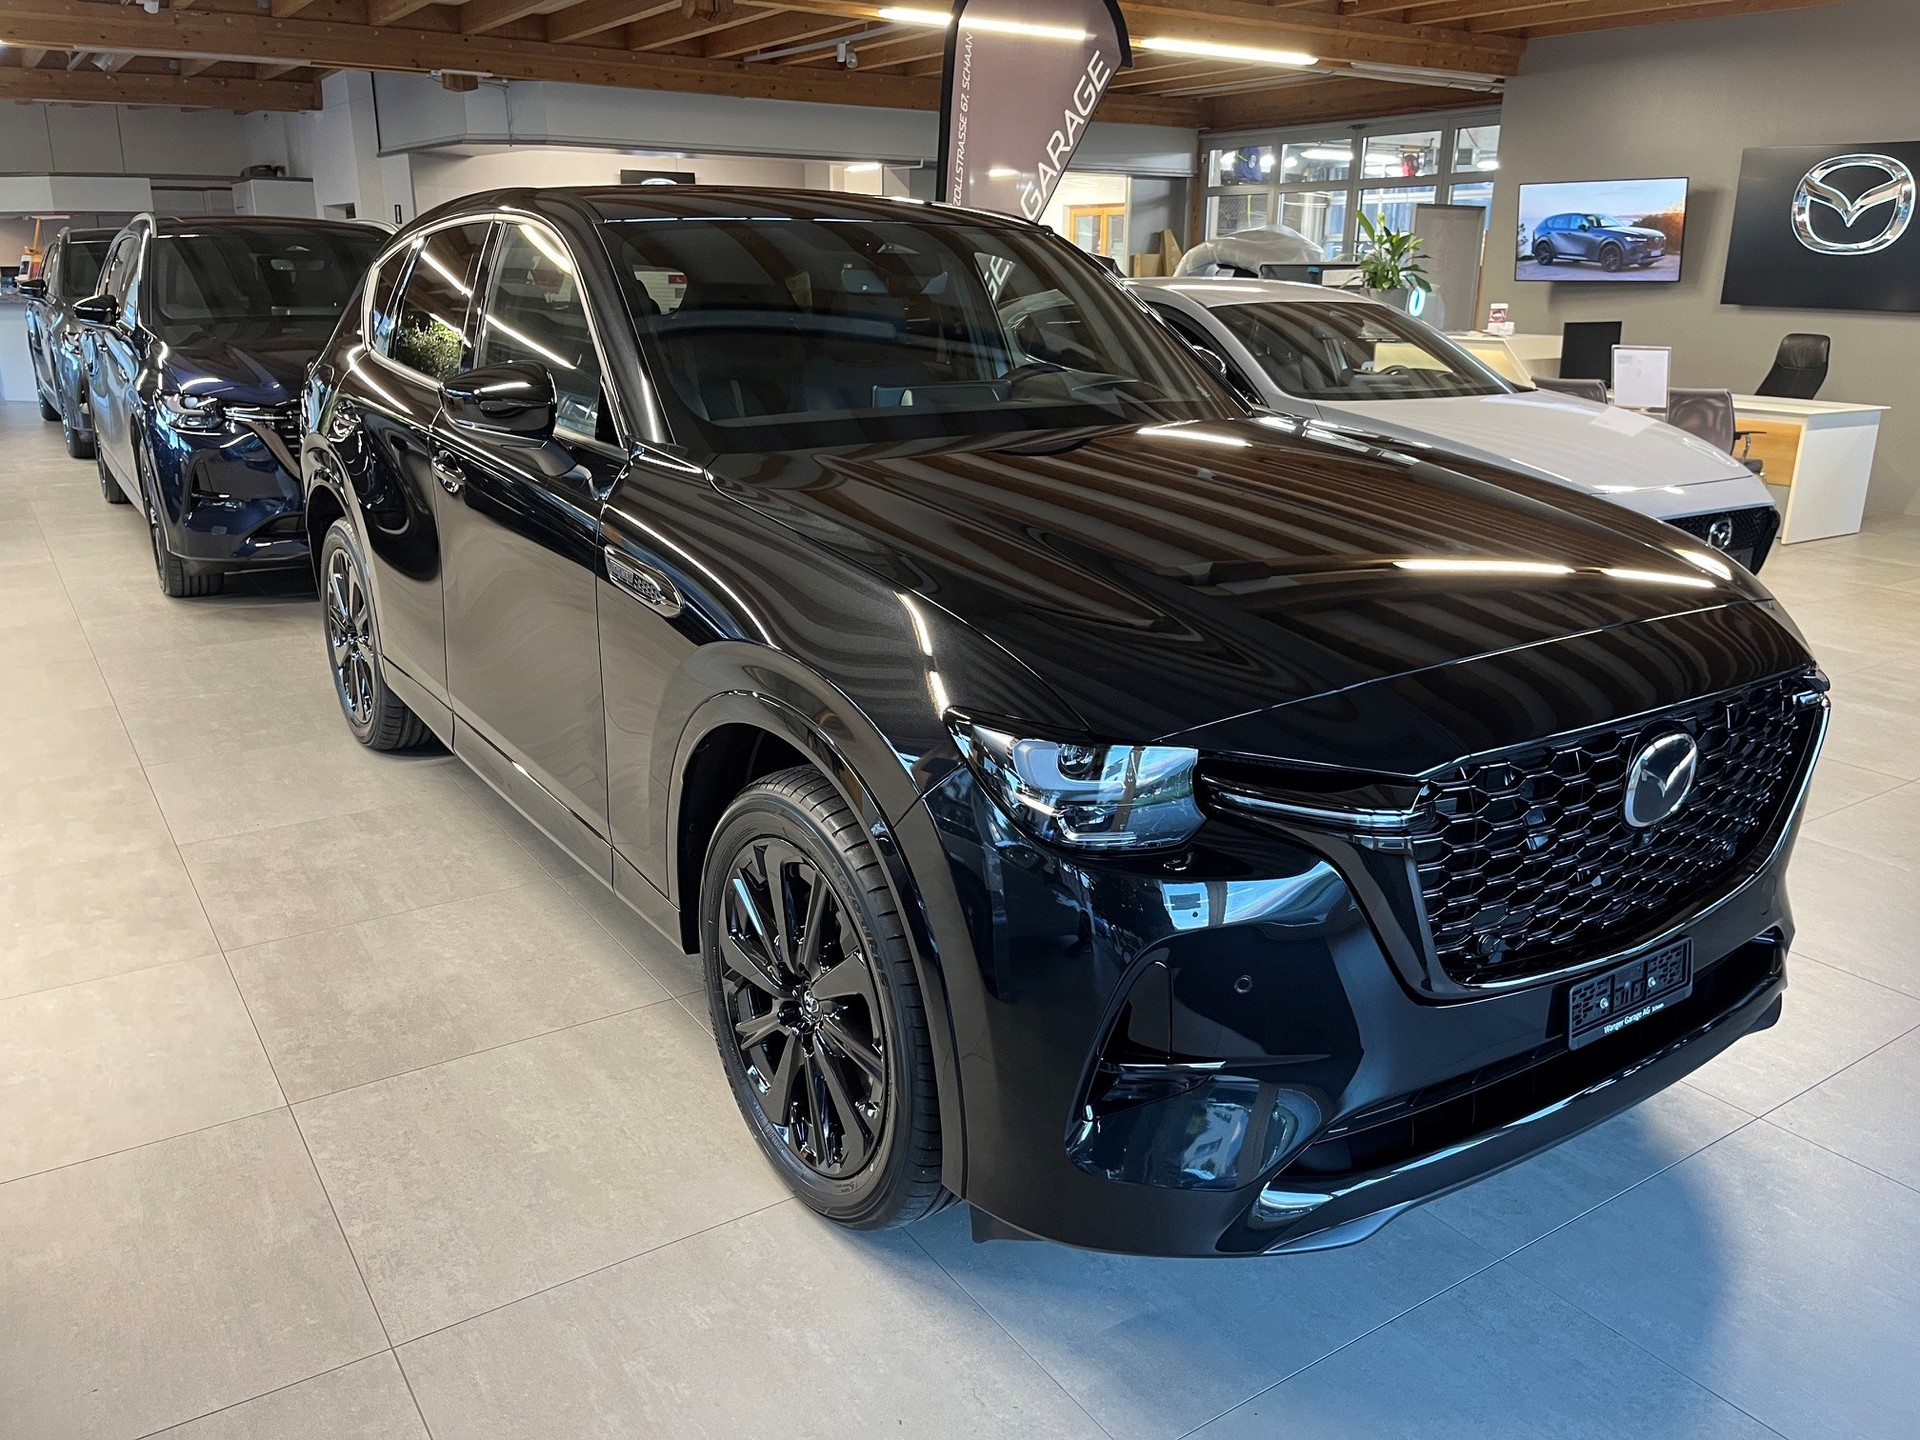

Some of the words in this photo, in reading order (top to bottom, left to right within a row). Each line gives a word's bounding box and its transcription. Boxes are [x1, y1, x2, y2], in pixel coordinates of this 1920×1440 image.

[952, 113, 968, 207] ZOLLSTRASSE
[961, 32, 974, 91] SCHAAN
[1020, 50, 1111, 221] GARAGE
